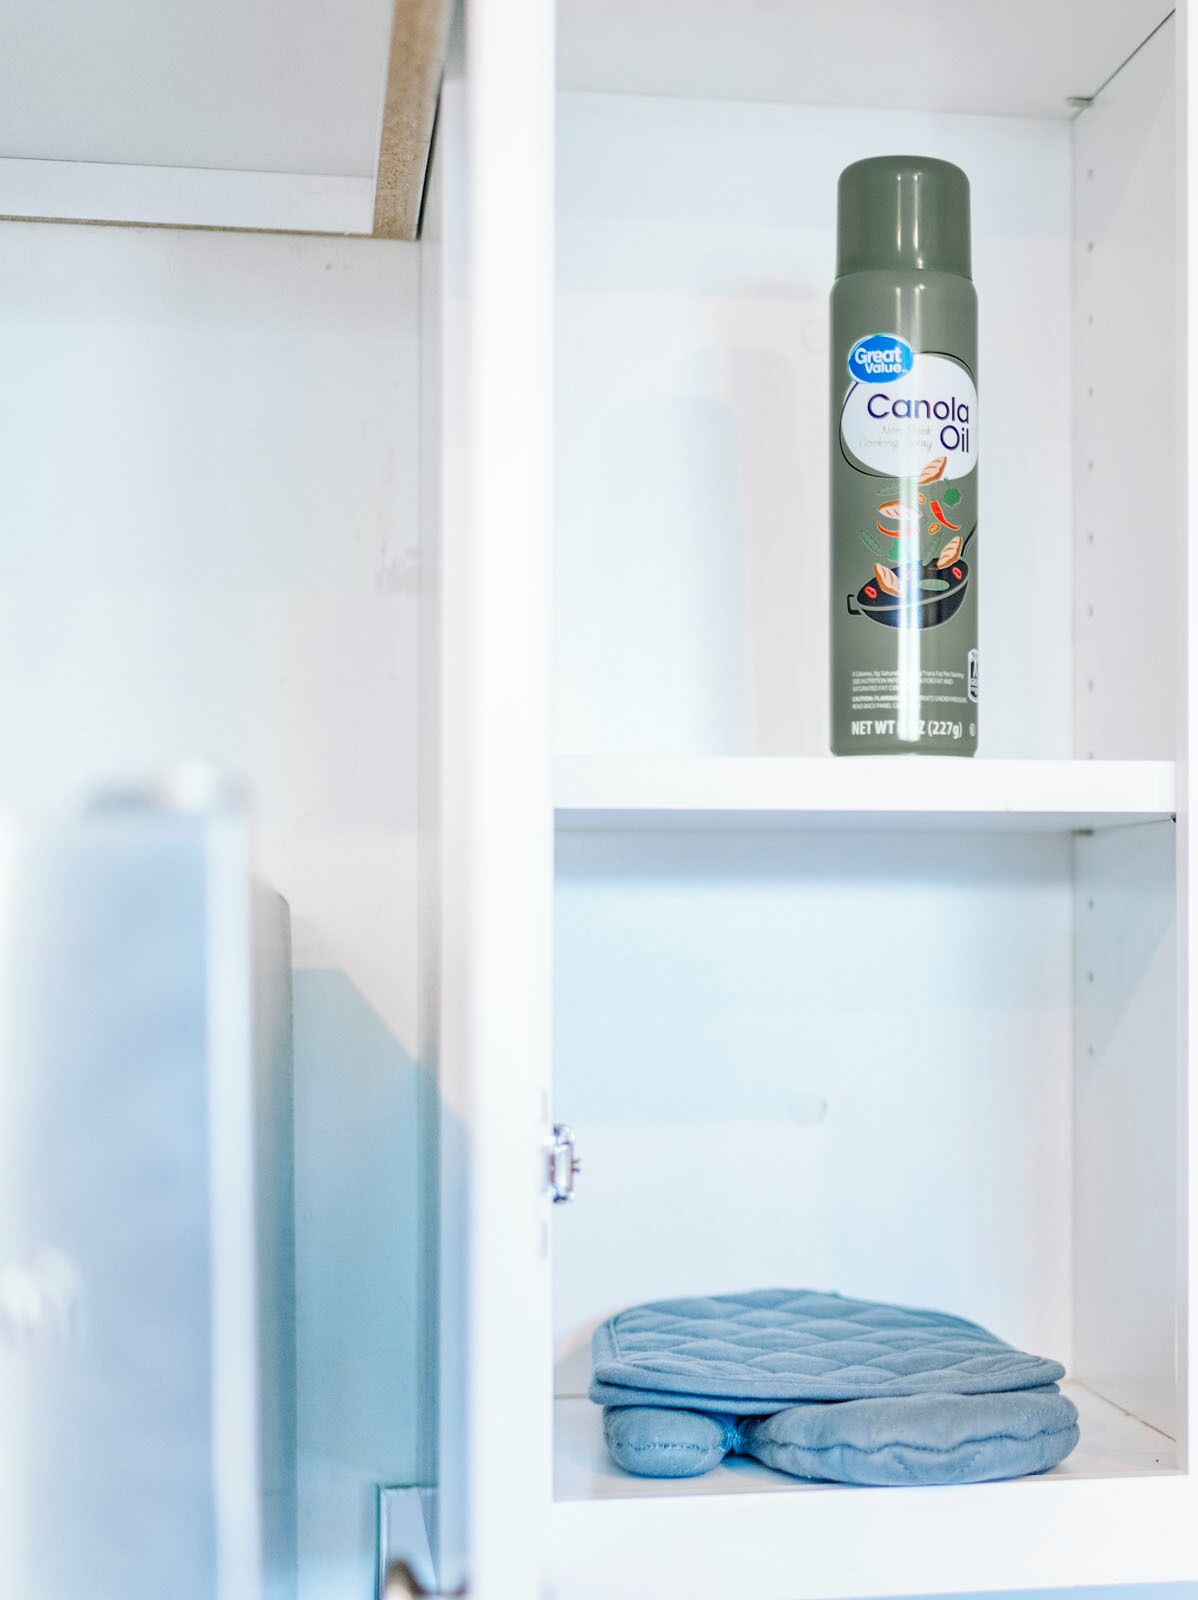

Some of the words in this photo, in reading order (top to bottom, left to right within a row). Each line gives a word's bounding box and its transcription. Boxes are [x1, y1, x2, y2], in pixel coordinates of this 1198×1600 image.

[855, 347, 902, 364] Great
[865, 361, 902, 374] Value
[867, 393, 969, 424] Canola
[940, 425, 969, 453] Oil
[851, 720, 872, 735] NET
[875, 720, 895, 734] WT
[928, 721, 963, 739] (227g)
